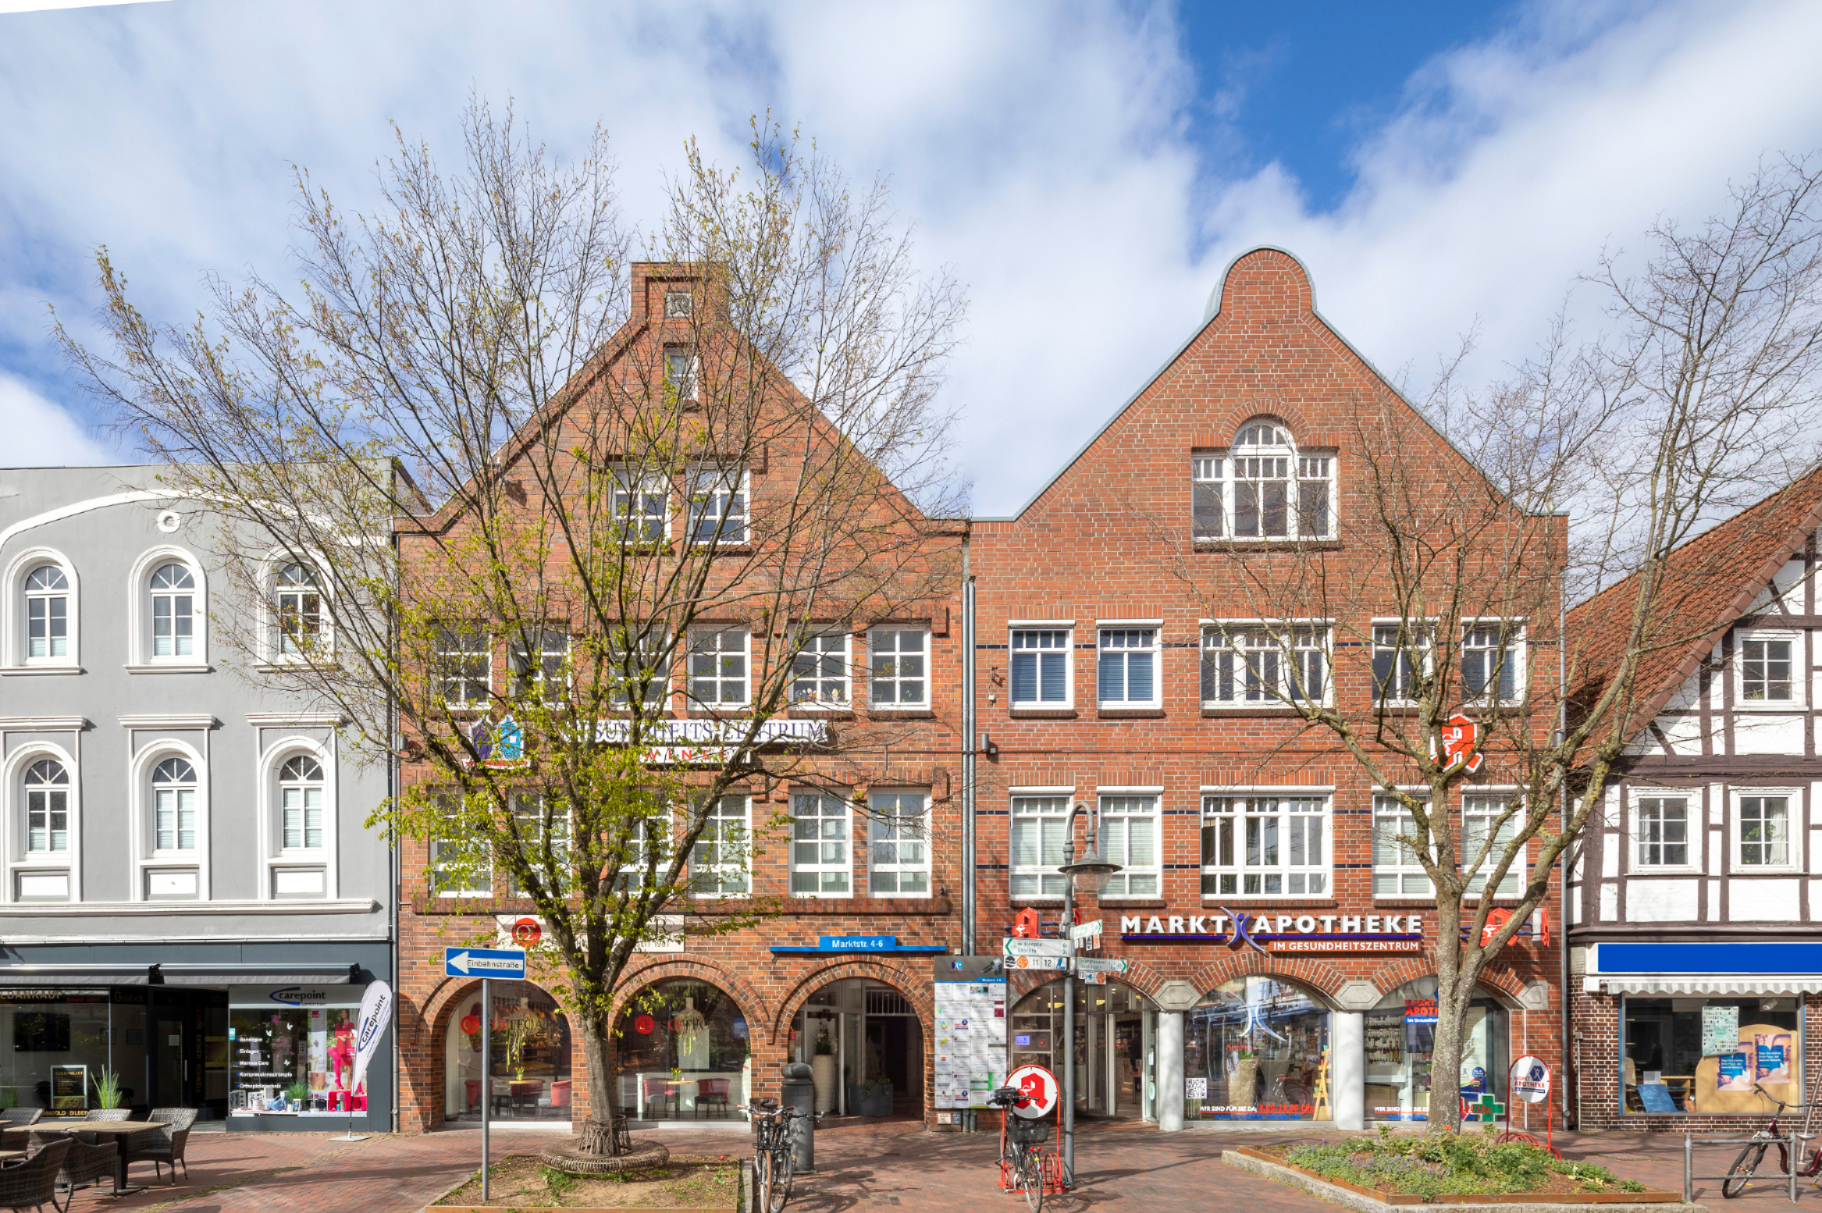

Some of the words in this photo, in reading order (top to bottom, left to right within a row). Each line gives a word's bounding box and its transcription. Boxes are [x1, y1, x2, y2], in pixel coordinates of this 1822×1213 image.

[1120, 915, 1229, 934] MARKT
[1251, 915, 1423, 934] APOTHEKE
[832, 940, 869, 948] Marktstr.
[870, 940, 884, 948] 4-6
[1273, 942, 1285, 951] IM
[1289, 941, 1419, 951] GESUNDHEITSZENTRUM
[467, 959, 519, 968] Einbahnstraße
[279, 990, 326, 1001] carepoint
[362, 994, 386, 1043] carepoint
